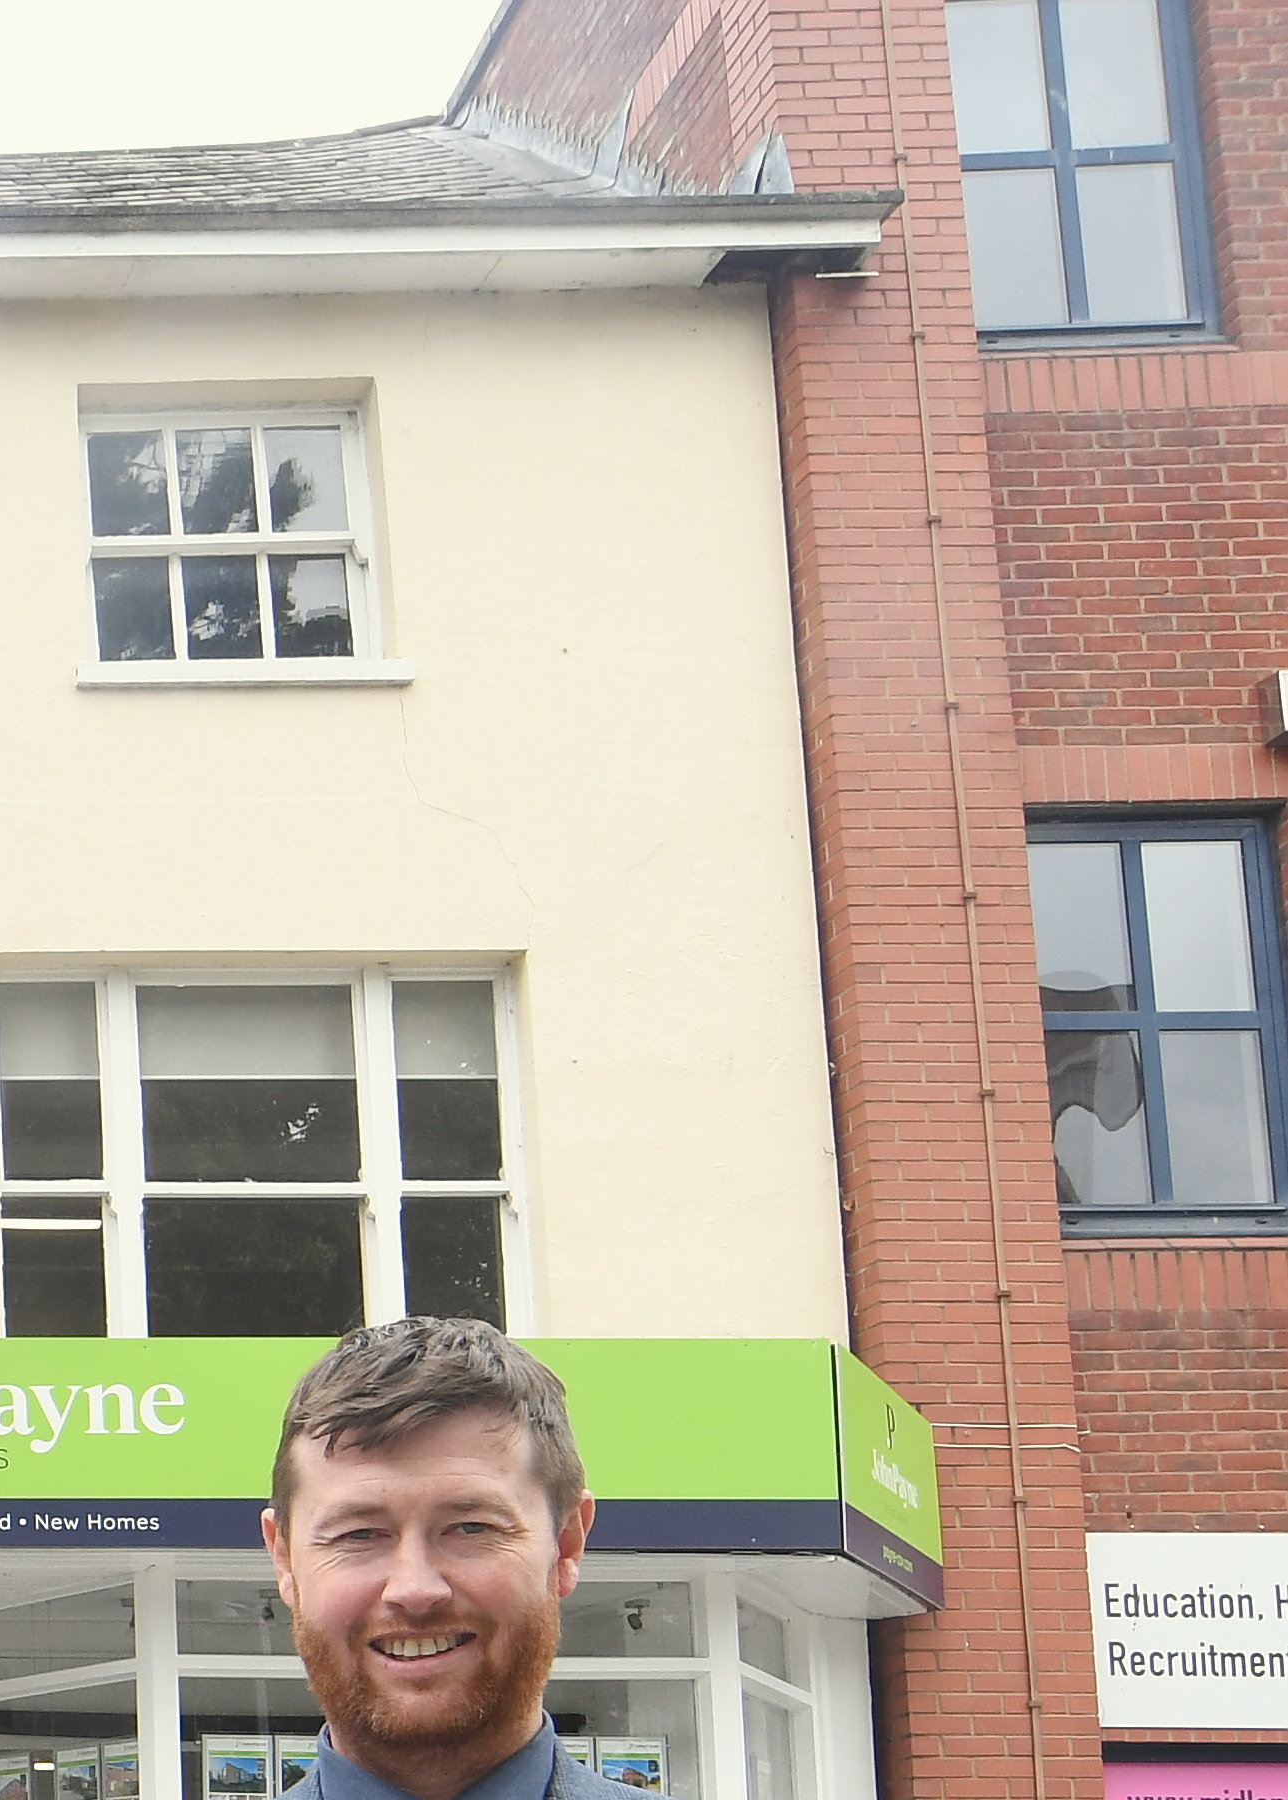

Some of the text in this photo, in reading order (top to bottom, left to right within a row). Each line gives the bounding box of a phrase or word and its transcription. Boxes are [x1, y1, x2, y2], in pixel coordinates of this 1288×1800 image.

[35, 1514, 79, 1531] New
[87, 1514, 160, 1531] Homes
[1104, 1582, 1264, 1621] Education,
[1108, 1641, 1288, 1677] Recruitmen
